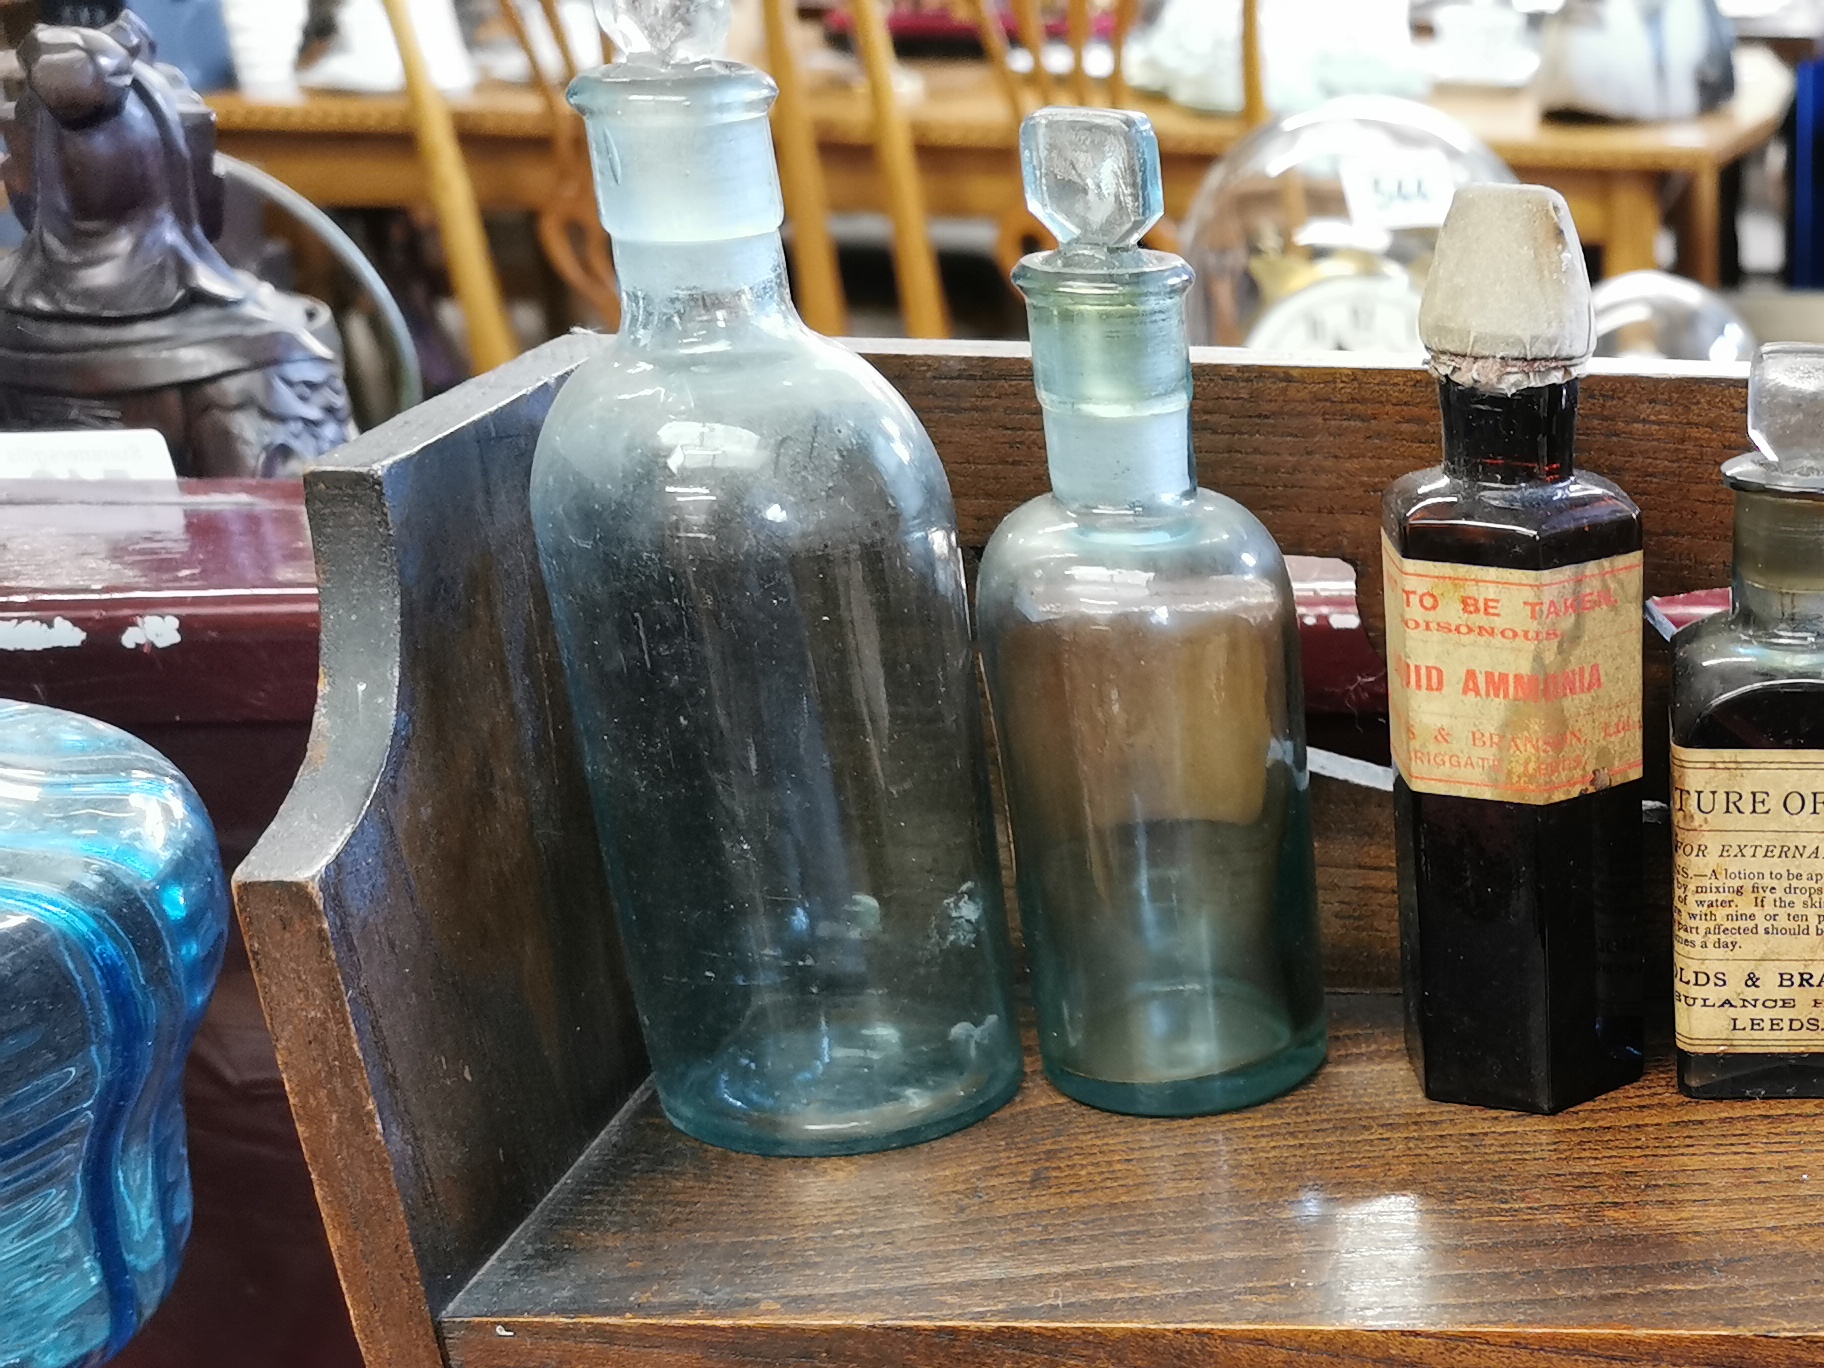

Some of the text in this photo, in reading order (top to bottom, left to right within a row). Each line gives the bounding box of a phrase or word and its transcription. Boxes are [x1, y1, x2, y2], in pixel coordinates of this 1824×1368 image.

[1402, 588, 1439, 612] TO
[1462, 595, 1500, 617] BE
[1401, 615, 1565, 642] OISONOUS.
[1461, 663, 1602, 702] AMMONIA
[1434, 727, 1451, 744] &
[1674, 786, 1770, 815] TURE
[1675, 840, 1708, 858] FOR
[1724, 868, 1764, 881] lotion
[1769, 870, 1783, 881] to
[1786, 868, 1803, 881] be
[1676, 877, 1688, 895] by
[1695, 883, 1744, 896] mixing
[1752, 882, 1777, 894] five
[1784, 883, 1823, 898] drops
[1677, 894, 1688, 906] of
[1695, 898, 1738, 909] water.
[1754, 896, 1766, 908] If
[1774, 897, 1795, 908] the
[1688, 910, 1717, 921] with
[1726, 910, 1756, 921] nine
[1764, 912, 1779, 921] or
[1787, 911, 1809, 922] ten
[1677, 920, 1700, 935] part
[1705, 923, 1759, 936] affected
[1763, 924, 1810, 936] should
[1701, 941, 1708, 949] a
[1713, 938, 1742, 952] day.
[1745, 972, 1760, 988] &
[1731, 1017, 1824, 1032] LEEDS.
